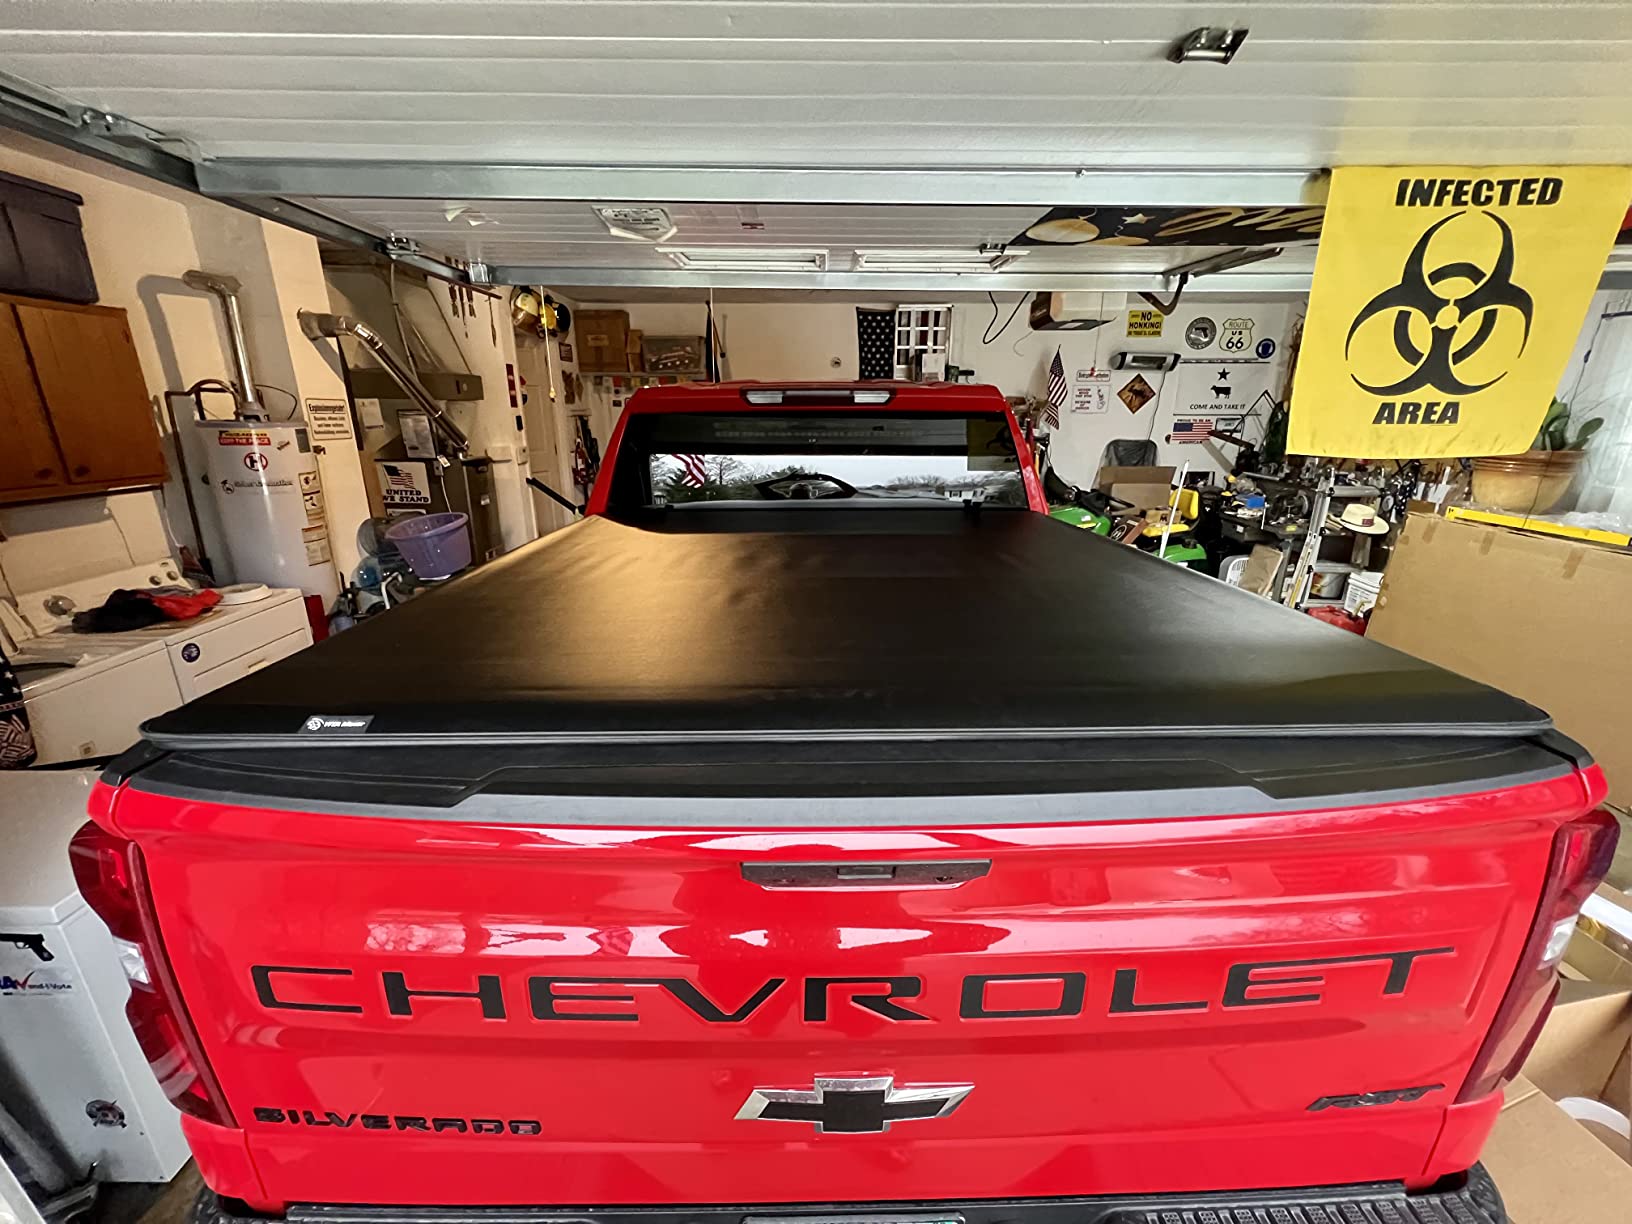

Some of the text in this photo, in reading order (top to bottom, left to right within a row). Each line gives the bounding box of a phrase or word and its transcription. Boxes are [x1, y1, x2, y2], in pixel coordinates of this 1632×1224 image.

[1395, 177, 1564, 207] INFECTED
[1140, 311, 1152, 321] NO
[1226, 337, 1244, 349] 66
[1372, 401, 1460, 425] AREA
[251, 946, 1455, 1022] CHEVROLET
[253, 1107, 543, 1135] SILVERADO
